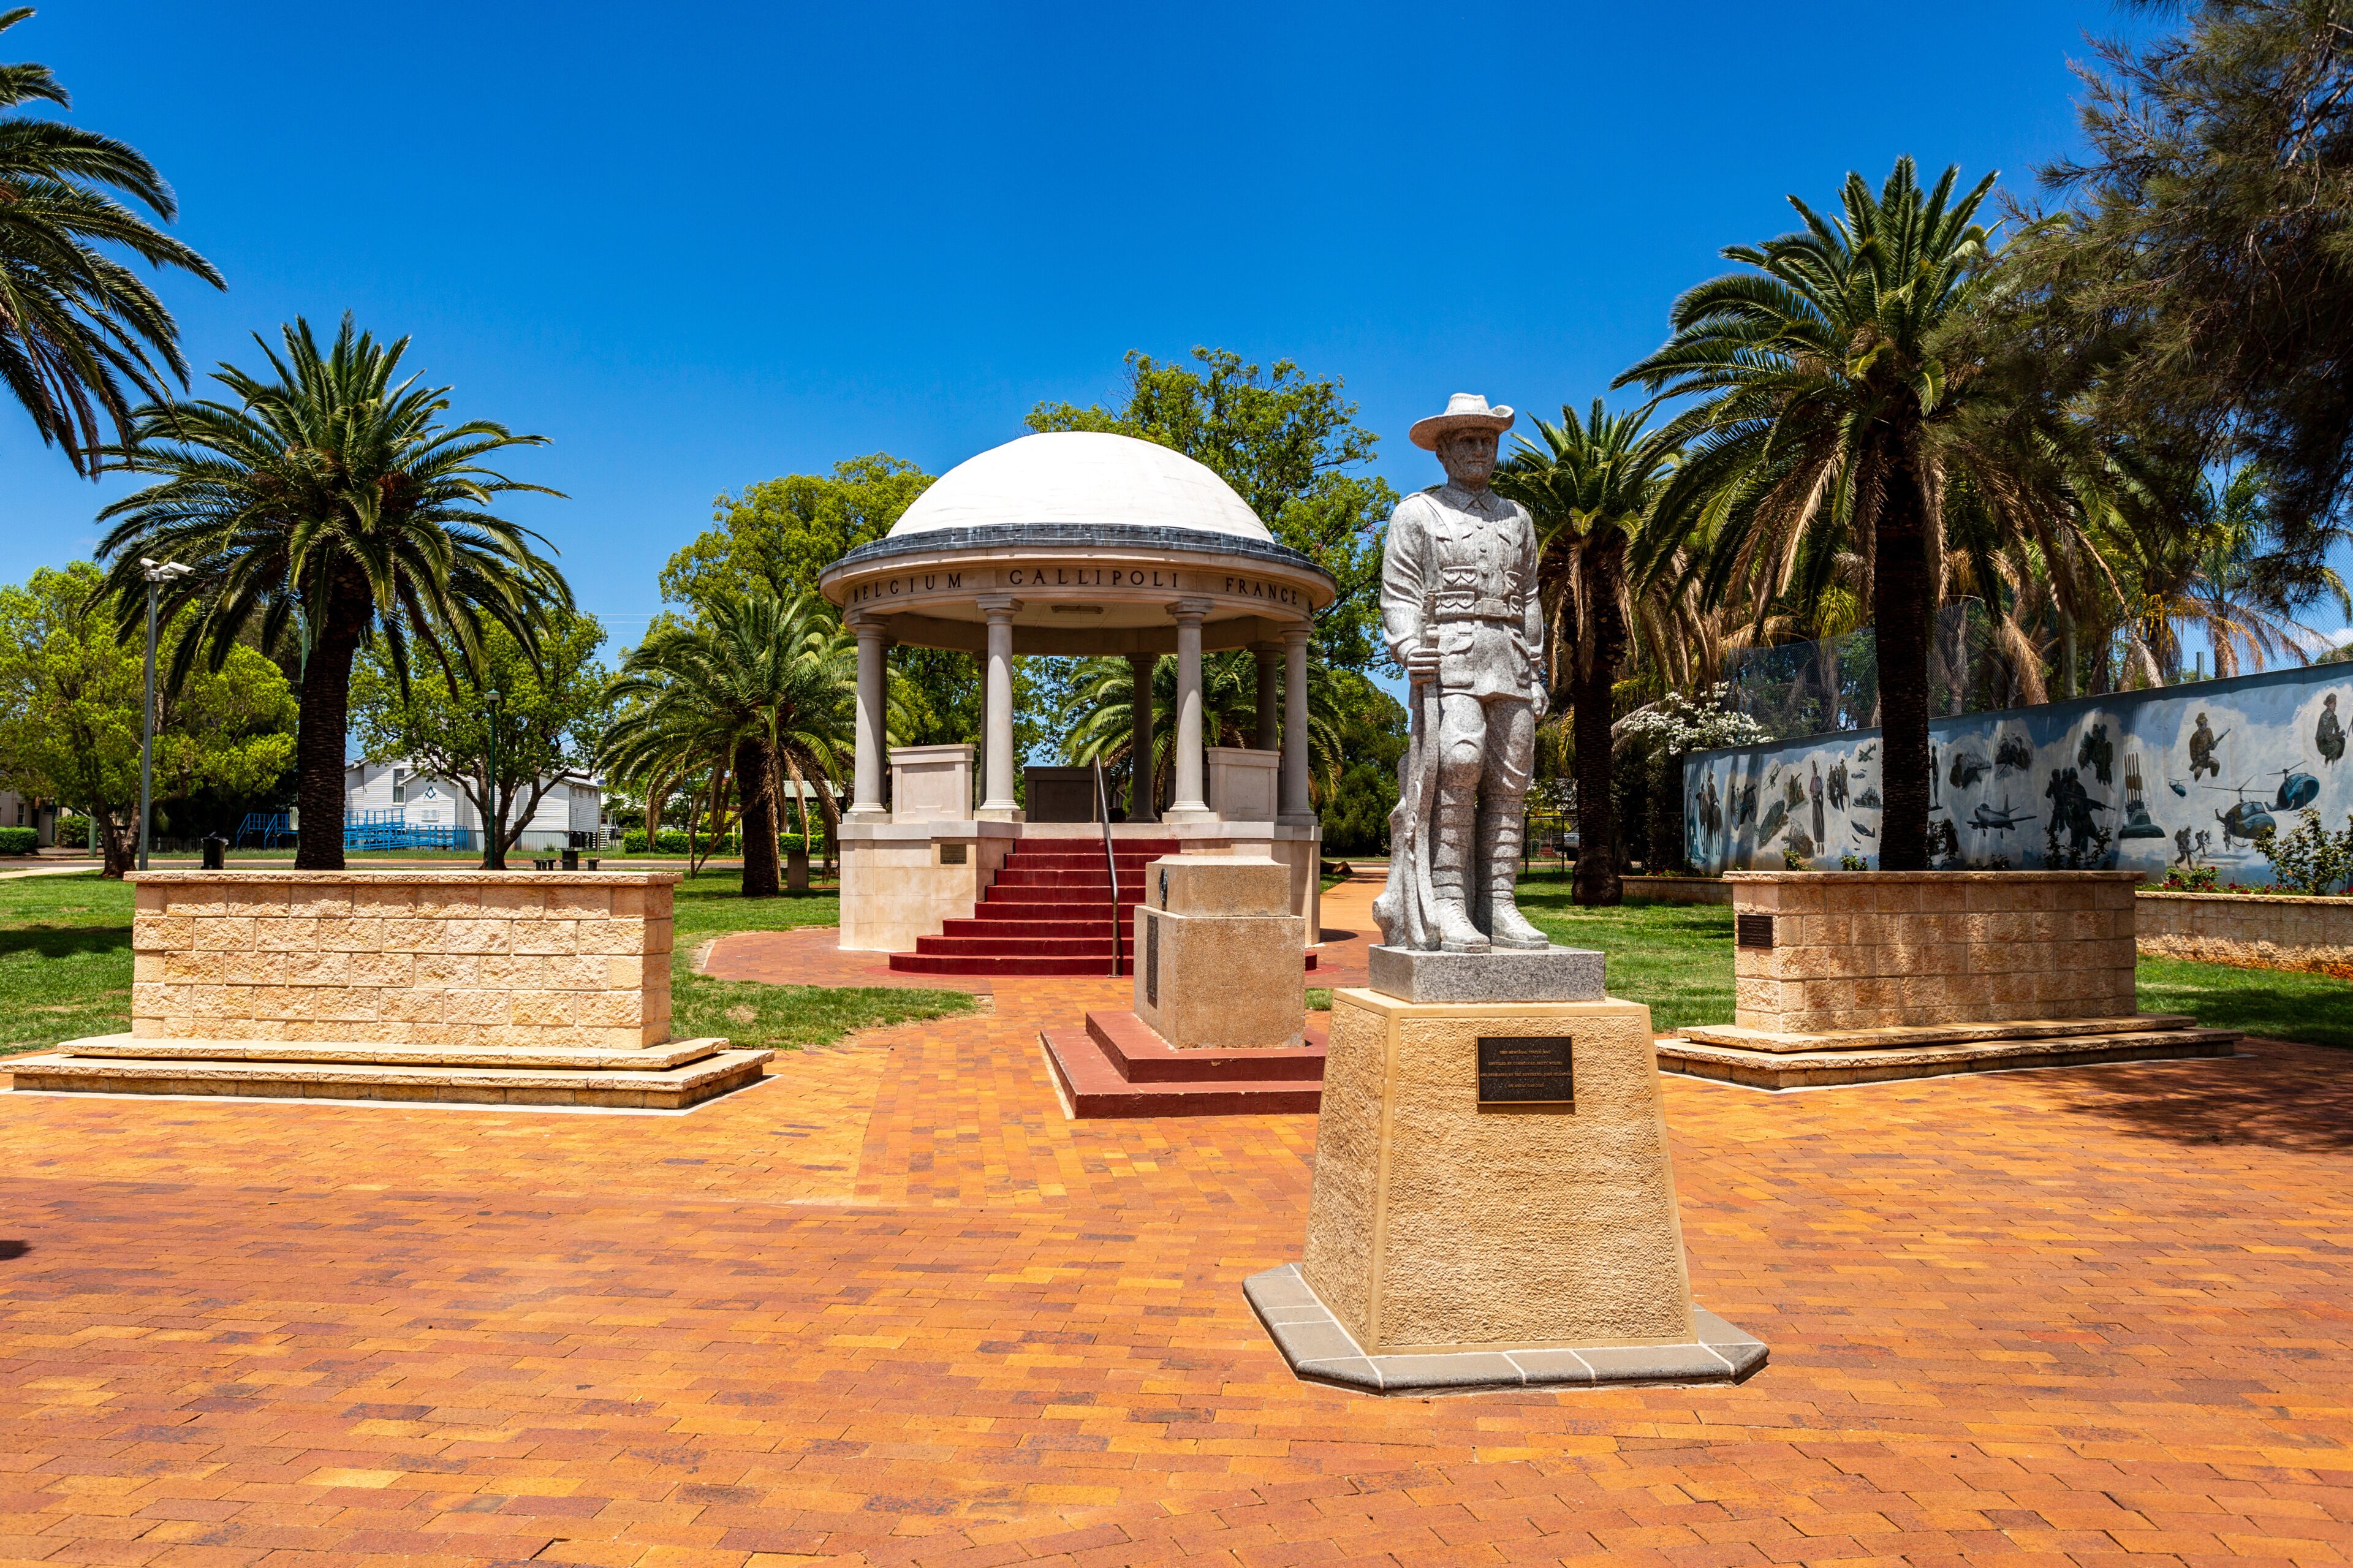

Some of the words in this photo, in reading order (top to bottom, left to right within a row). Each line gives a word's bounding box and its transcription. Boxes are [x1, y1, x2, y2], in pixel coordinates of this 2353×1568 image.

[854, 573, 961, 603] BELGIUM
[1009, 569, 1177, 588] GALLIPOLI
[1226, 578, 1297, 605] FRANCE
